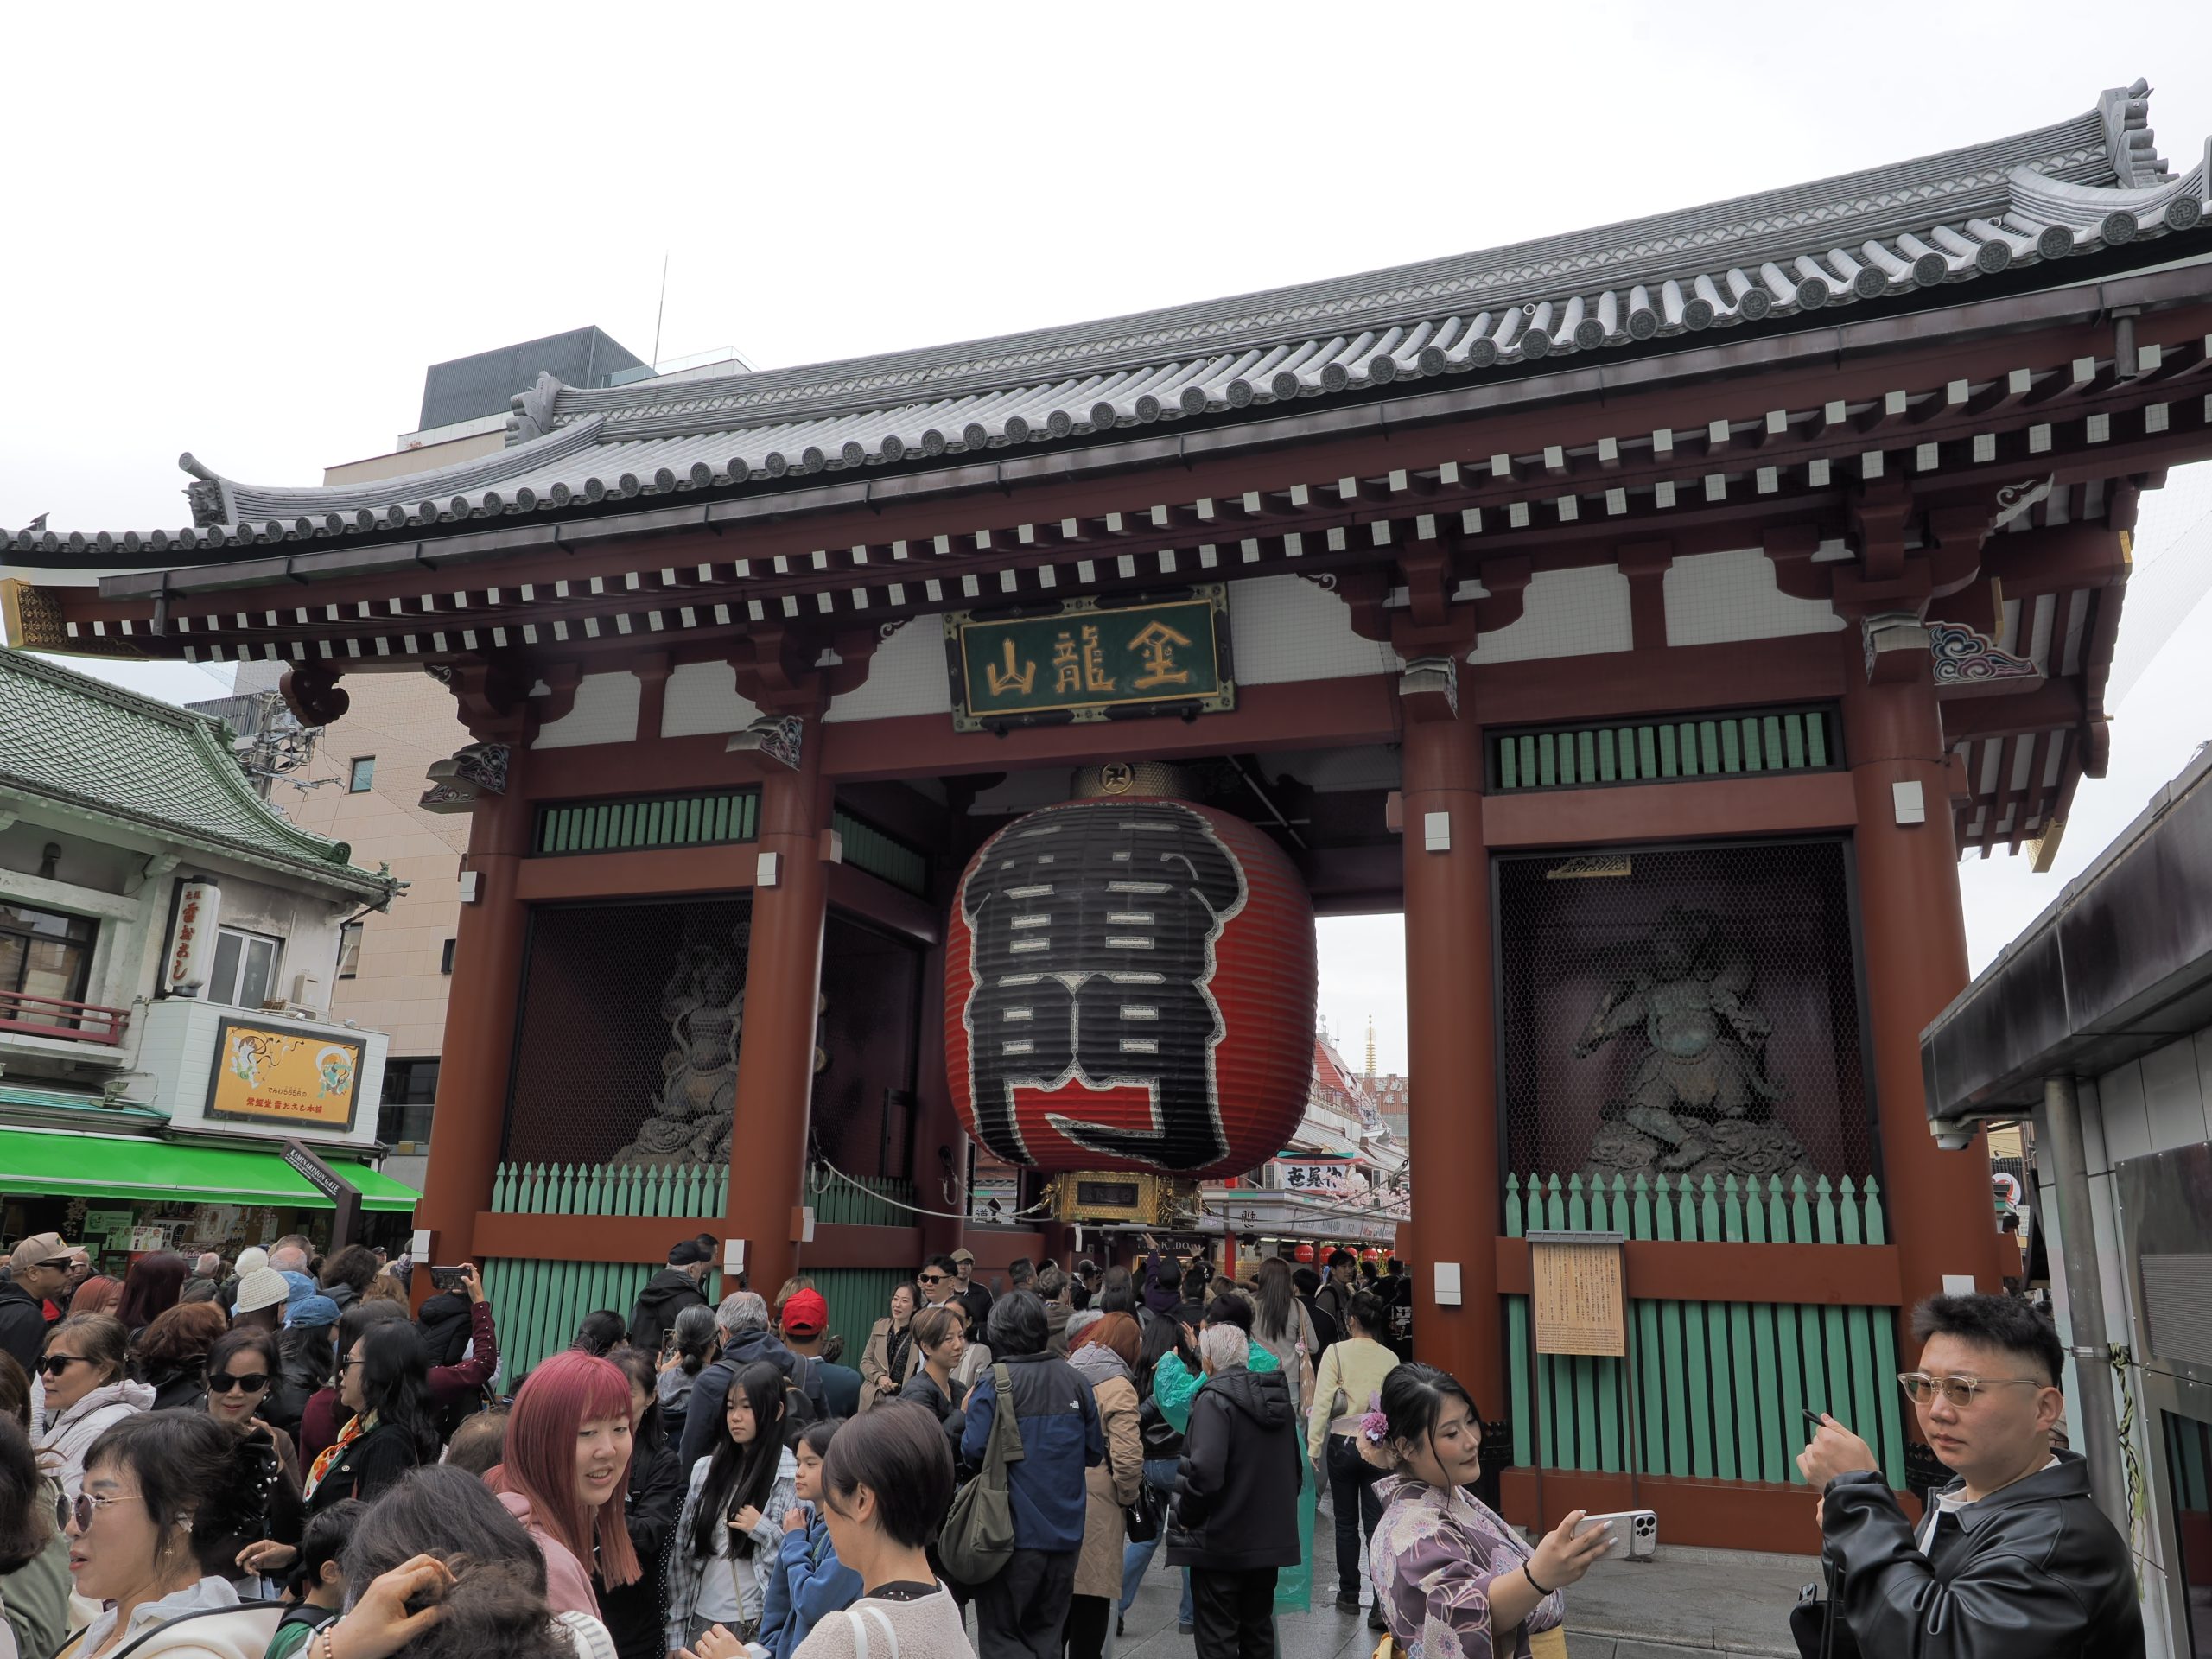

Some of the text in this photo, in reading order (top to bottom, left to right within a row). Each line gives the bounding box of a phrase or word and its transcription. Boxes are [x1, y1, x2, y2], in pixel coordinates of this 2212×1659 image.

[962, 801, 1249, 1172] 雷門
[289, 1149, 326, 1181] KAMINARIMON
[324, 1178, 340, 1192] GATE
